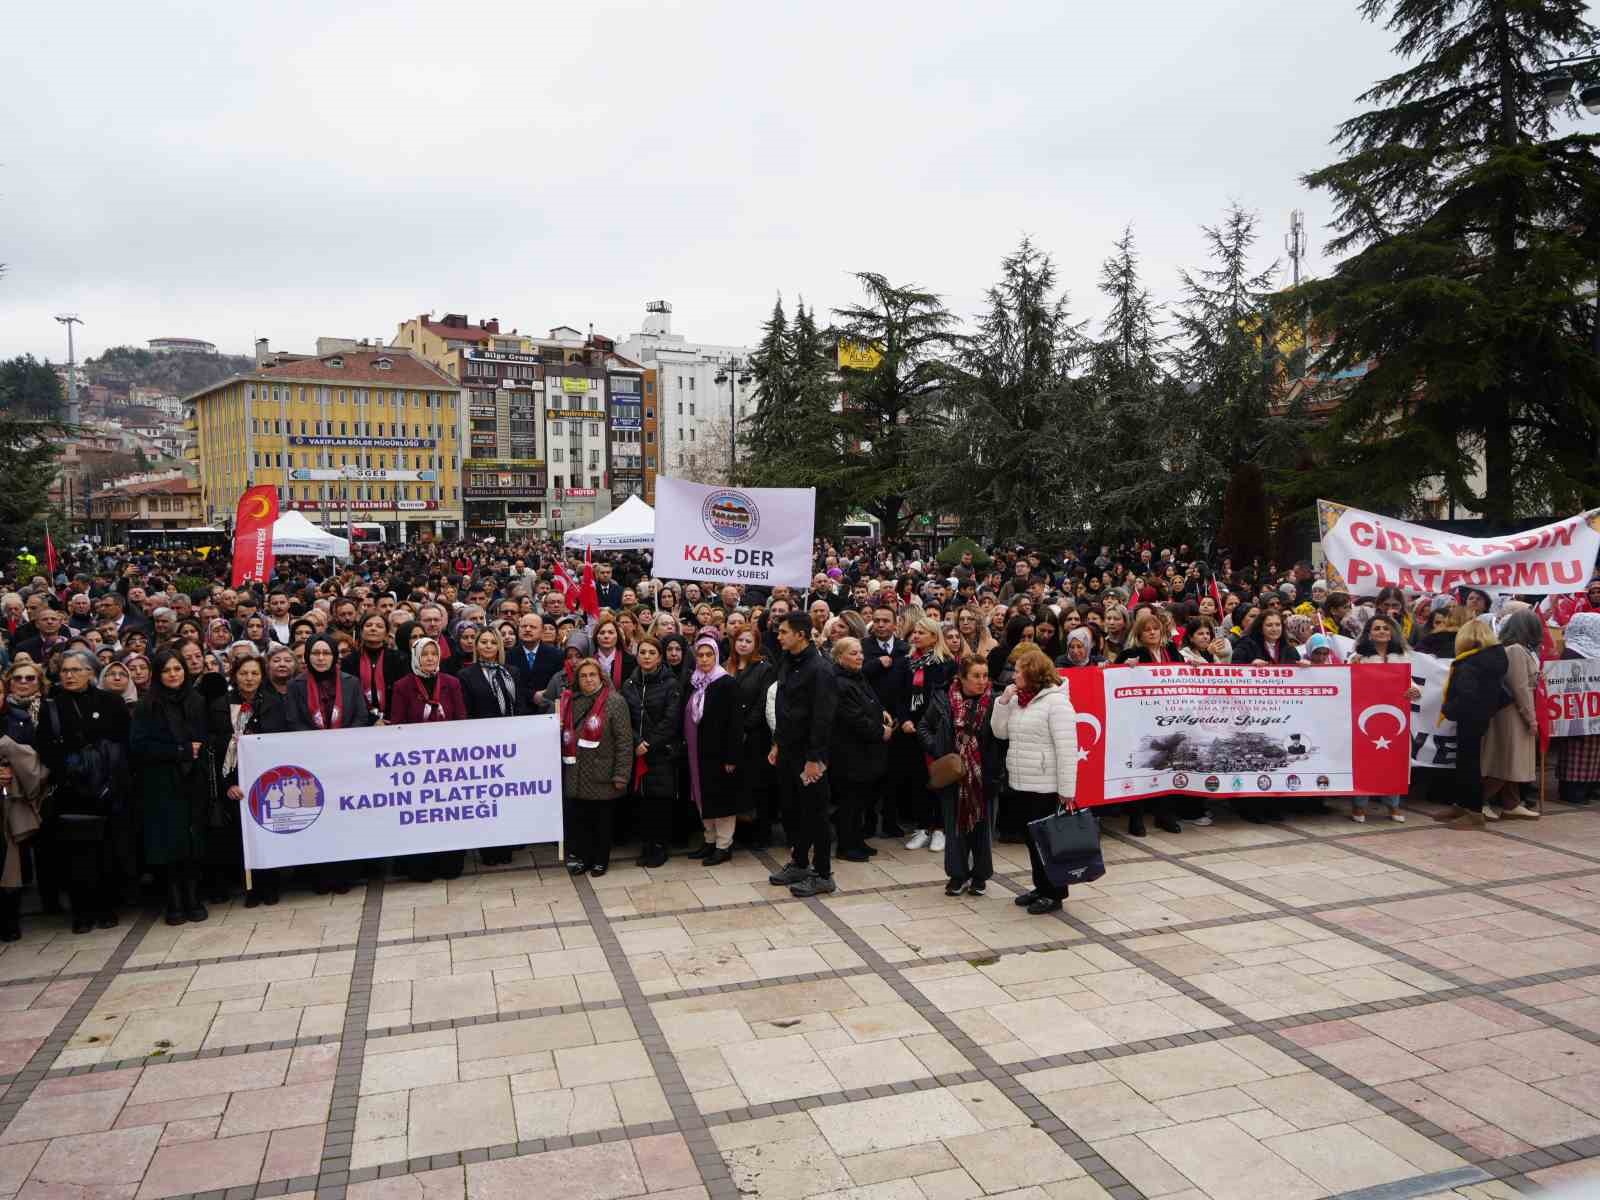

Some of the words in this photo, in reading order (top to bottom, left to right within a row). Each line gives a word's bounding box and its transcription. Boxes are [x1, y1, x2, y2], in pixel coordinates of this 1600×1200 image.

[348, 438, 372, 446] BÖLGE
[373, 438, 419, 447] MÜDÜRLÜĞÜ
[1349, 520, 1441, 557] CİDE
[1446, 522, 1577, 557] KADIN
[684, 544, 775, 567] KAS-DER
[692, 566, 735, 577] KADIKÖY
[1347, 558, 1584, 594] PLATFORMU
[1151, 668, 1172, 677] 10
[1177, 668, 1244, 677] ARALIK
[1249, 668, 1294, 677] 1919
[1117, 687, 1227, 697] KASTAMONU'DA
[1155, 714, 1229, 727] Gölgeden
[375, 743, 518, 769] KASTAMONU
[390, 771, 415, 787] 10
[423, 763, 505, 785] ARALIK
[339, 790, 412, 811] KADIN
[420, 779, 552, 805] PLATFORMU
[399, 800, 498, 826] DERNEĞİ
